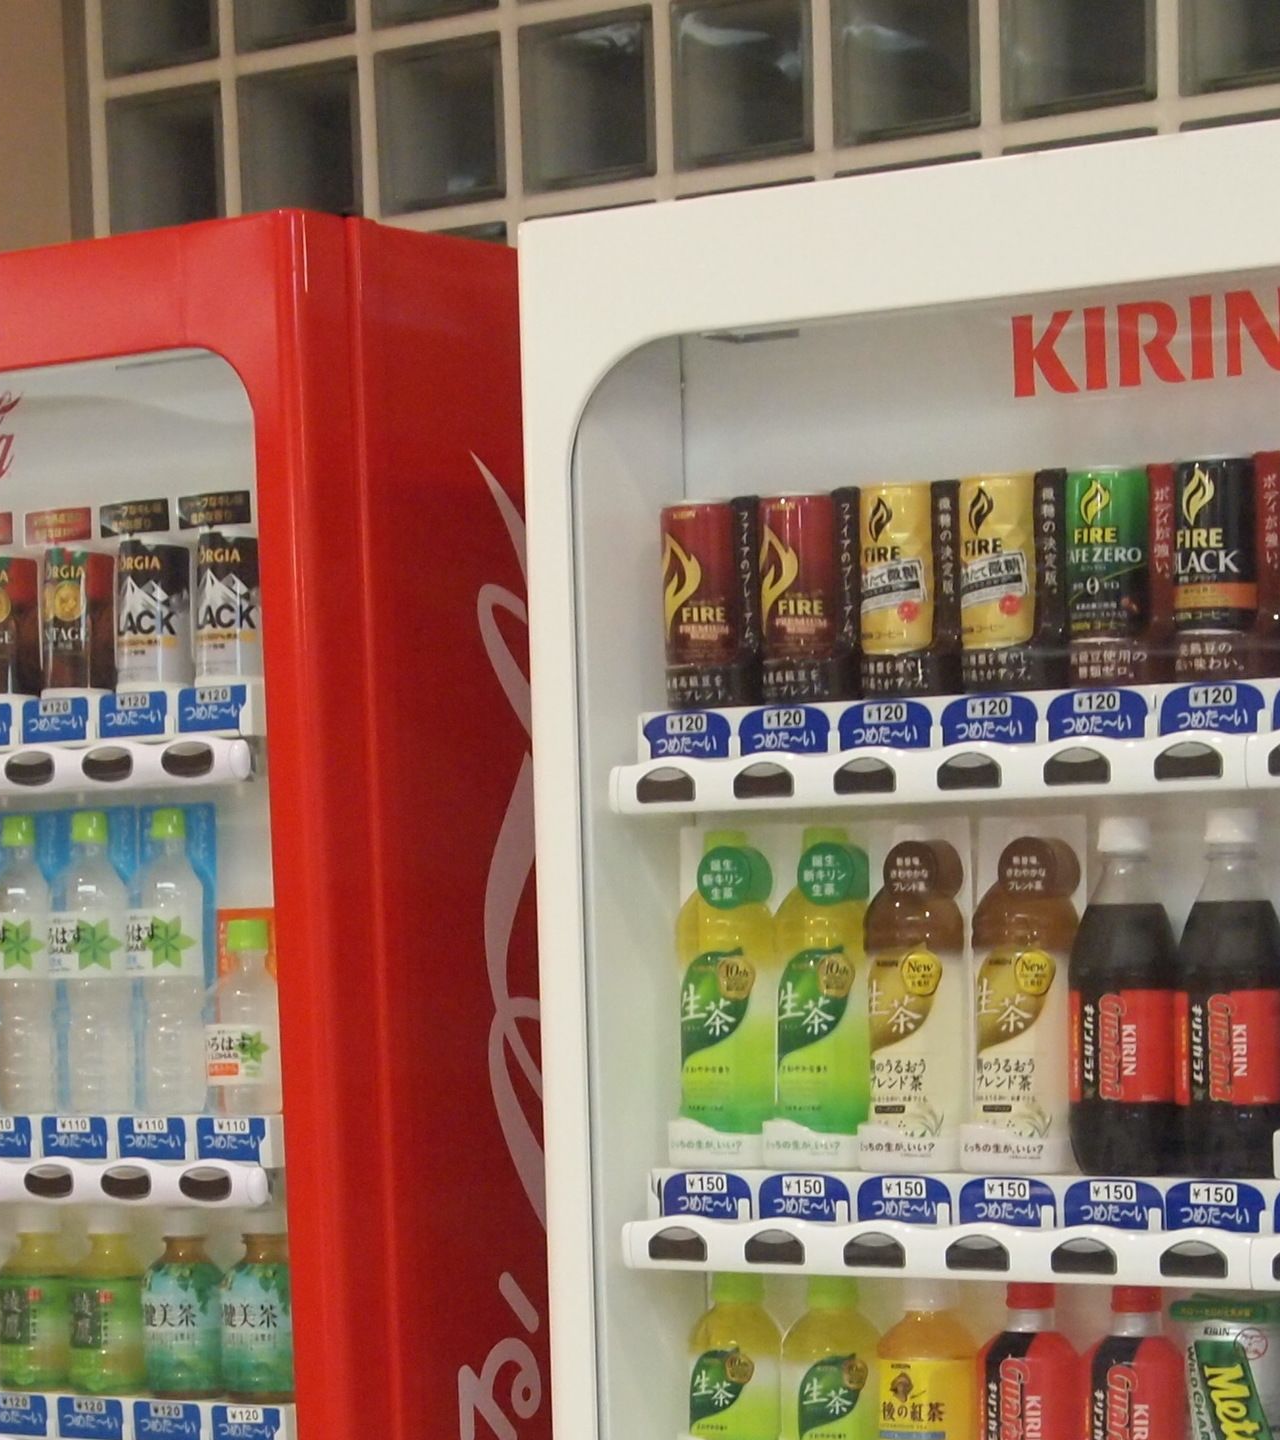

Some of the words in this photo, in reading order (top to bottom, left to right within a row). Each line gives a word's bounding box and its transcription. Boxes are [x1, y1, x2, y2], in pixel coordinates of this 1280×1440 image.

[1074, 528, 1117, 544] FIRE
[1176, 528, 1224, 549] FIRE
[864, 546, 901, 562] FIRE
[964, 538, 1002, 554] FIRE
[1093, 548, 1142, 564] ZERO
[682, 607, 725, 623] FIRE
[778, 600, 823, 615] FIRE
[971, 699, 1009, 716] ¥120
[1078, 692, 1117, 710] ¥120
[670, 715, 704, 732] ¥120
[767, 710, 803, 727] ¥120
[908, 960, 934, 973] New
[1020, 959, 1046, 972] New
[1121, 1024, 1137, 1076] KIRIN
[1232, 1024, 1248, 1077] KIRIN
[687, 1175, 725, 1192] ¥150
[885, 1180, 924, 1197] ¥150
[987, 1181, 1027, 1198] ¥150
[1192, 1185, 1235, 1203] ¥150
[1203, 1327, 1230, 1337] KIRIN
[692, 1369, 734, 1407] 生茶
[803, 1378, 853, 1416] 生茶
